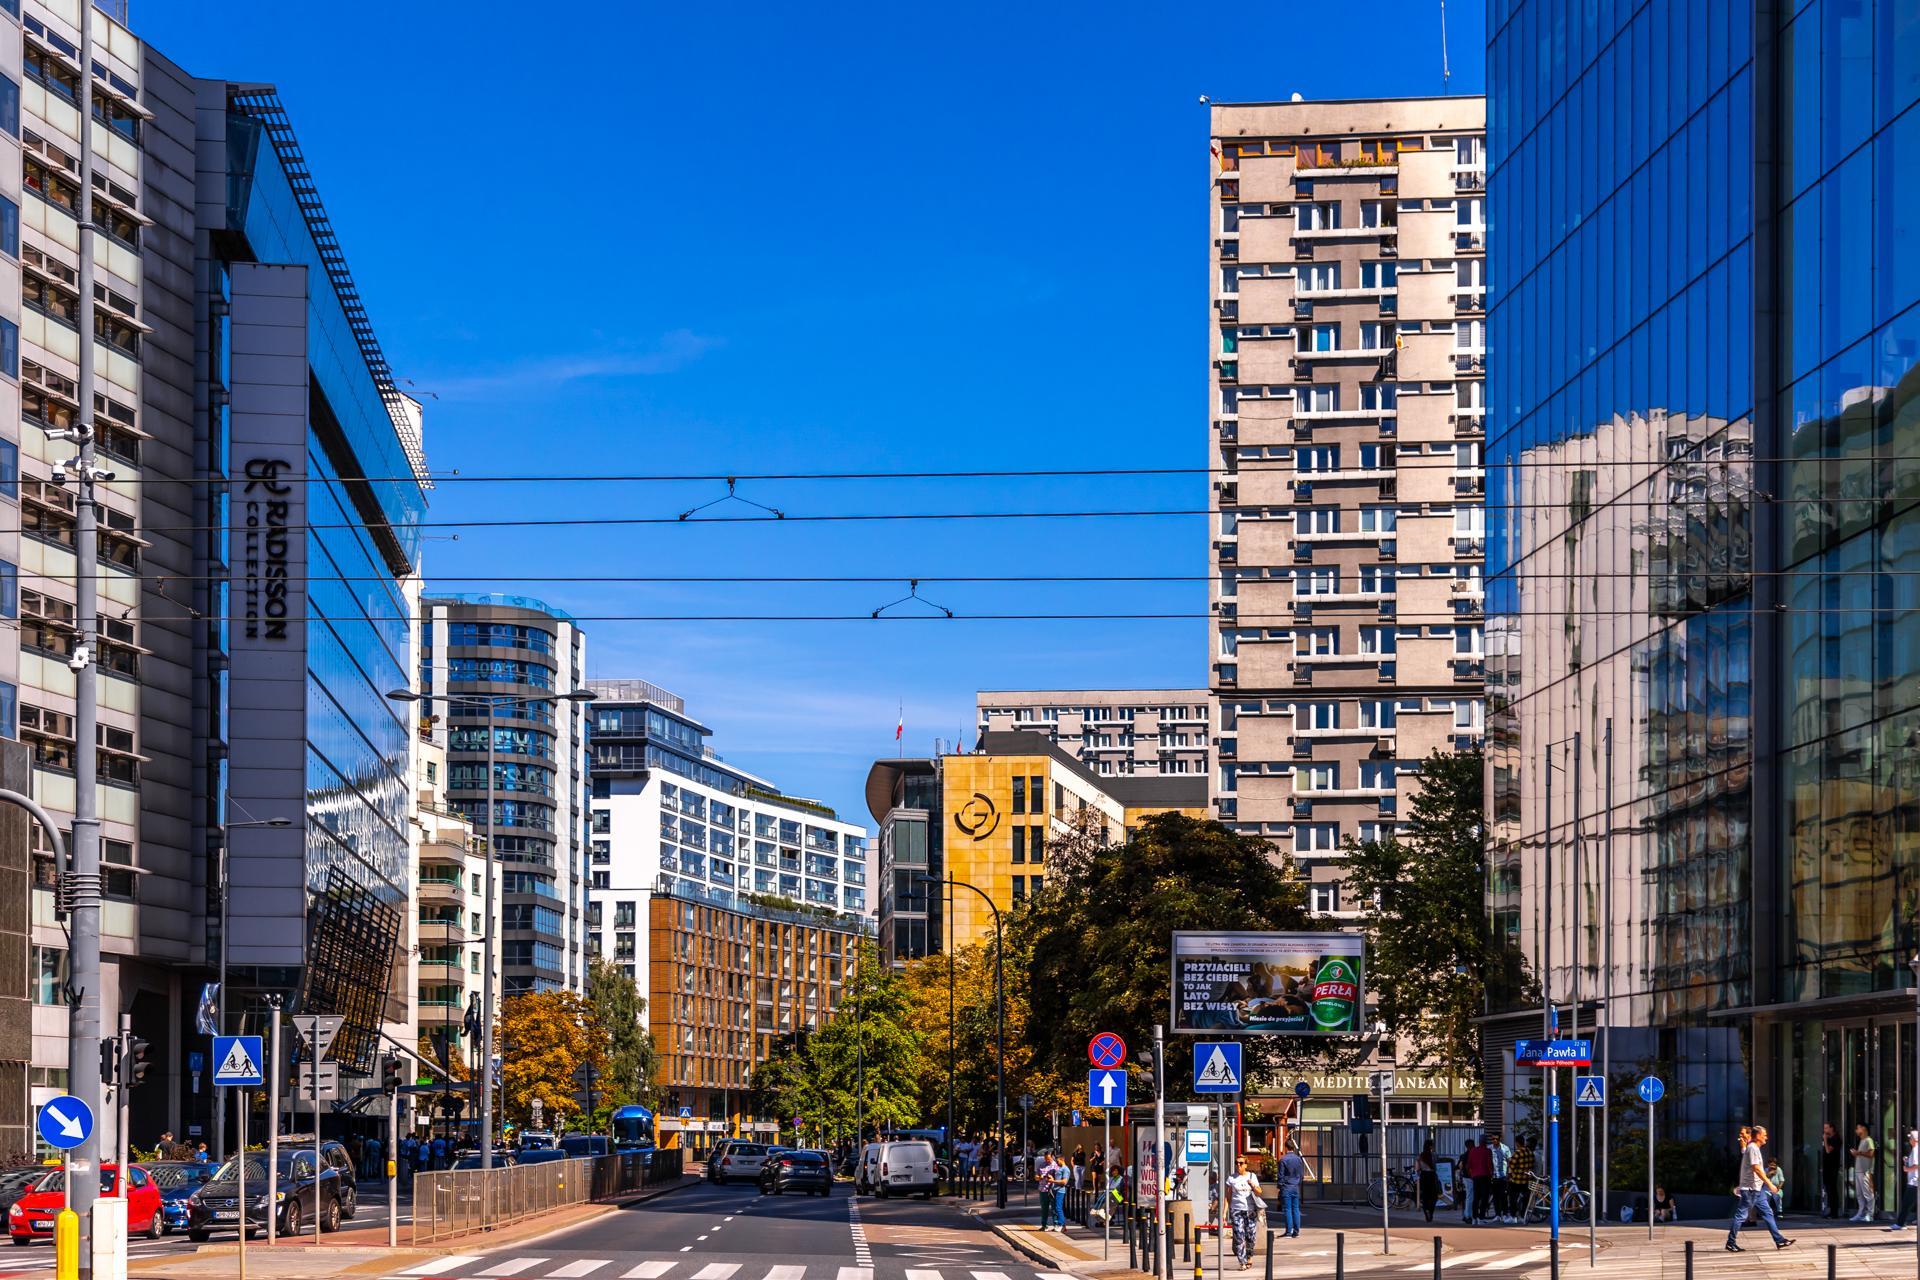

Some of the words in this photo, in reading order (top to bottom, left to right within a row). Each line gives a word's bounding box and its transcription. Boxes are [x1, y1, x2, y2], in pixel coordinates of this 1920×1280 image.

[246, 502, 259, 639] COLLECTION
[265, 500, 289, 640] RADISSON
[1183, 962, 1251, 972] PRZYJACIELE
[1183, 973, 1204, 982] BEZ
[1205, 973, 1239, 982] CIEBIE
[1183, 992, 1210, 1000] LATO
[1314, 984, 1353, 998] PERŁA
[1183, 1002, 1204, 1011] BEZ
[1205, 1002, 1239, 1011] WISŁY
[1521, 1047, 1543, 1058] Jana
[1547, 1046, 1577, 1058] Pawła
[1580, 1047, 1586, 1057] II
[1313, 1076, 1449, 1089] MEDITEANEAN
